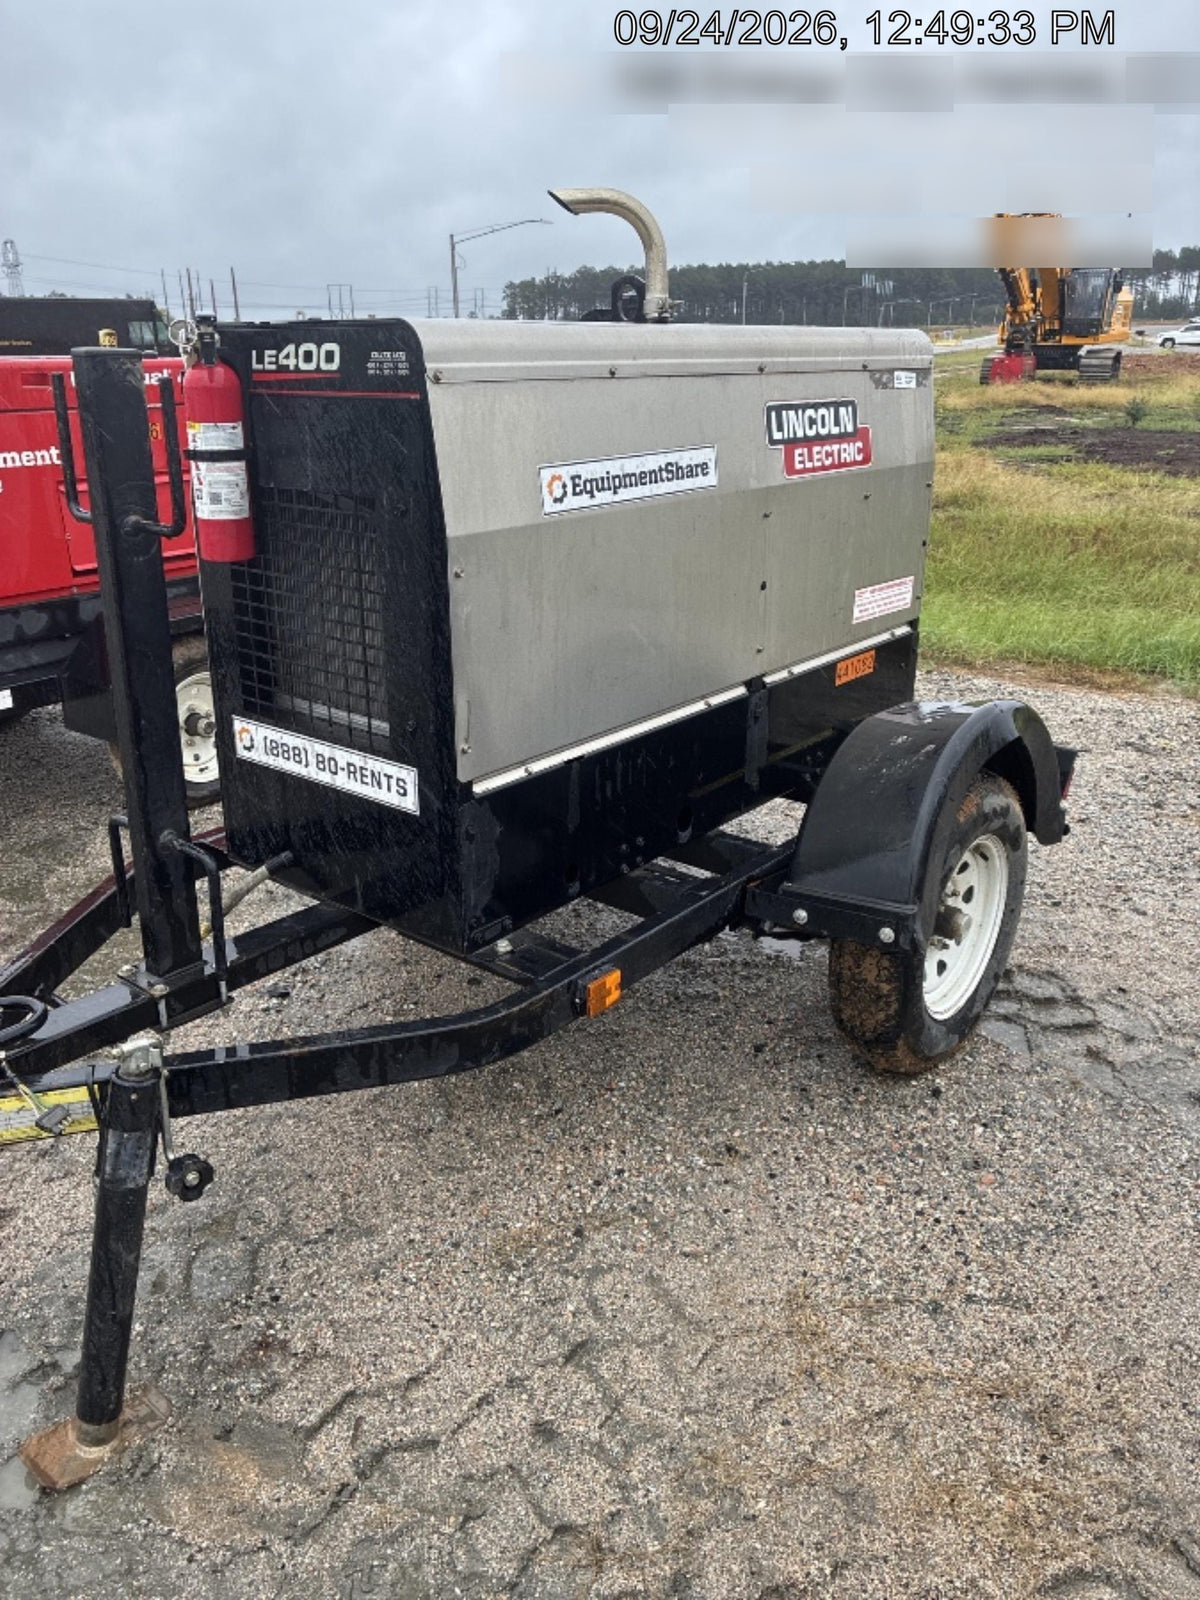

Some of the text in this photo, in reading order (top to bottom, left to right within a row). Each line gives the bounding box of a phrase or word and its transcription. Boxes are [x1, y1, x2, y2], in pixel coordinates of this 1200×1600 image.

[252, 342, 340, 371] LE400
[771, 405, 854, 440] LINCOLN
[794, 441, 863, 470] ELECTRIC
[570, 461, 709, 498] EquipmentShare
[263, 736, 408, 797] (888) 80-RENTS
